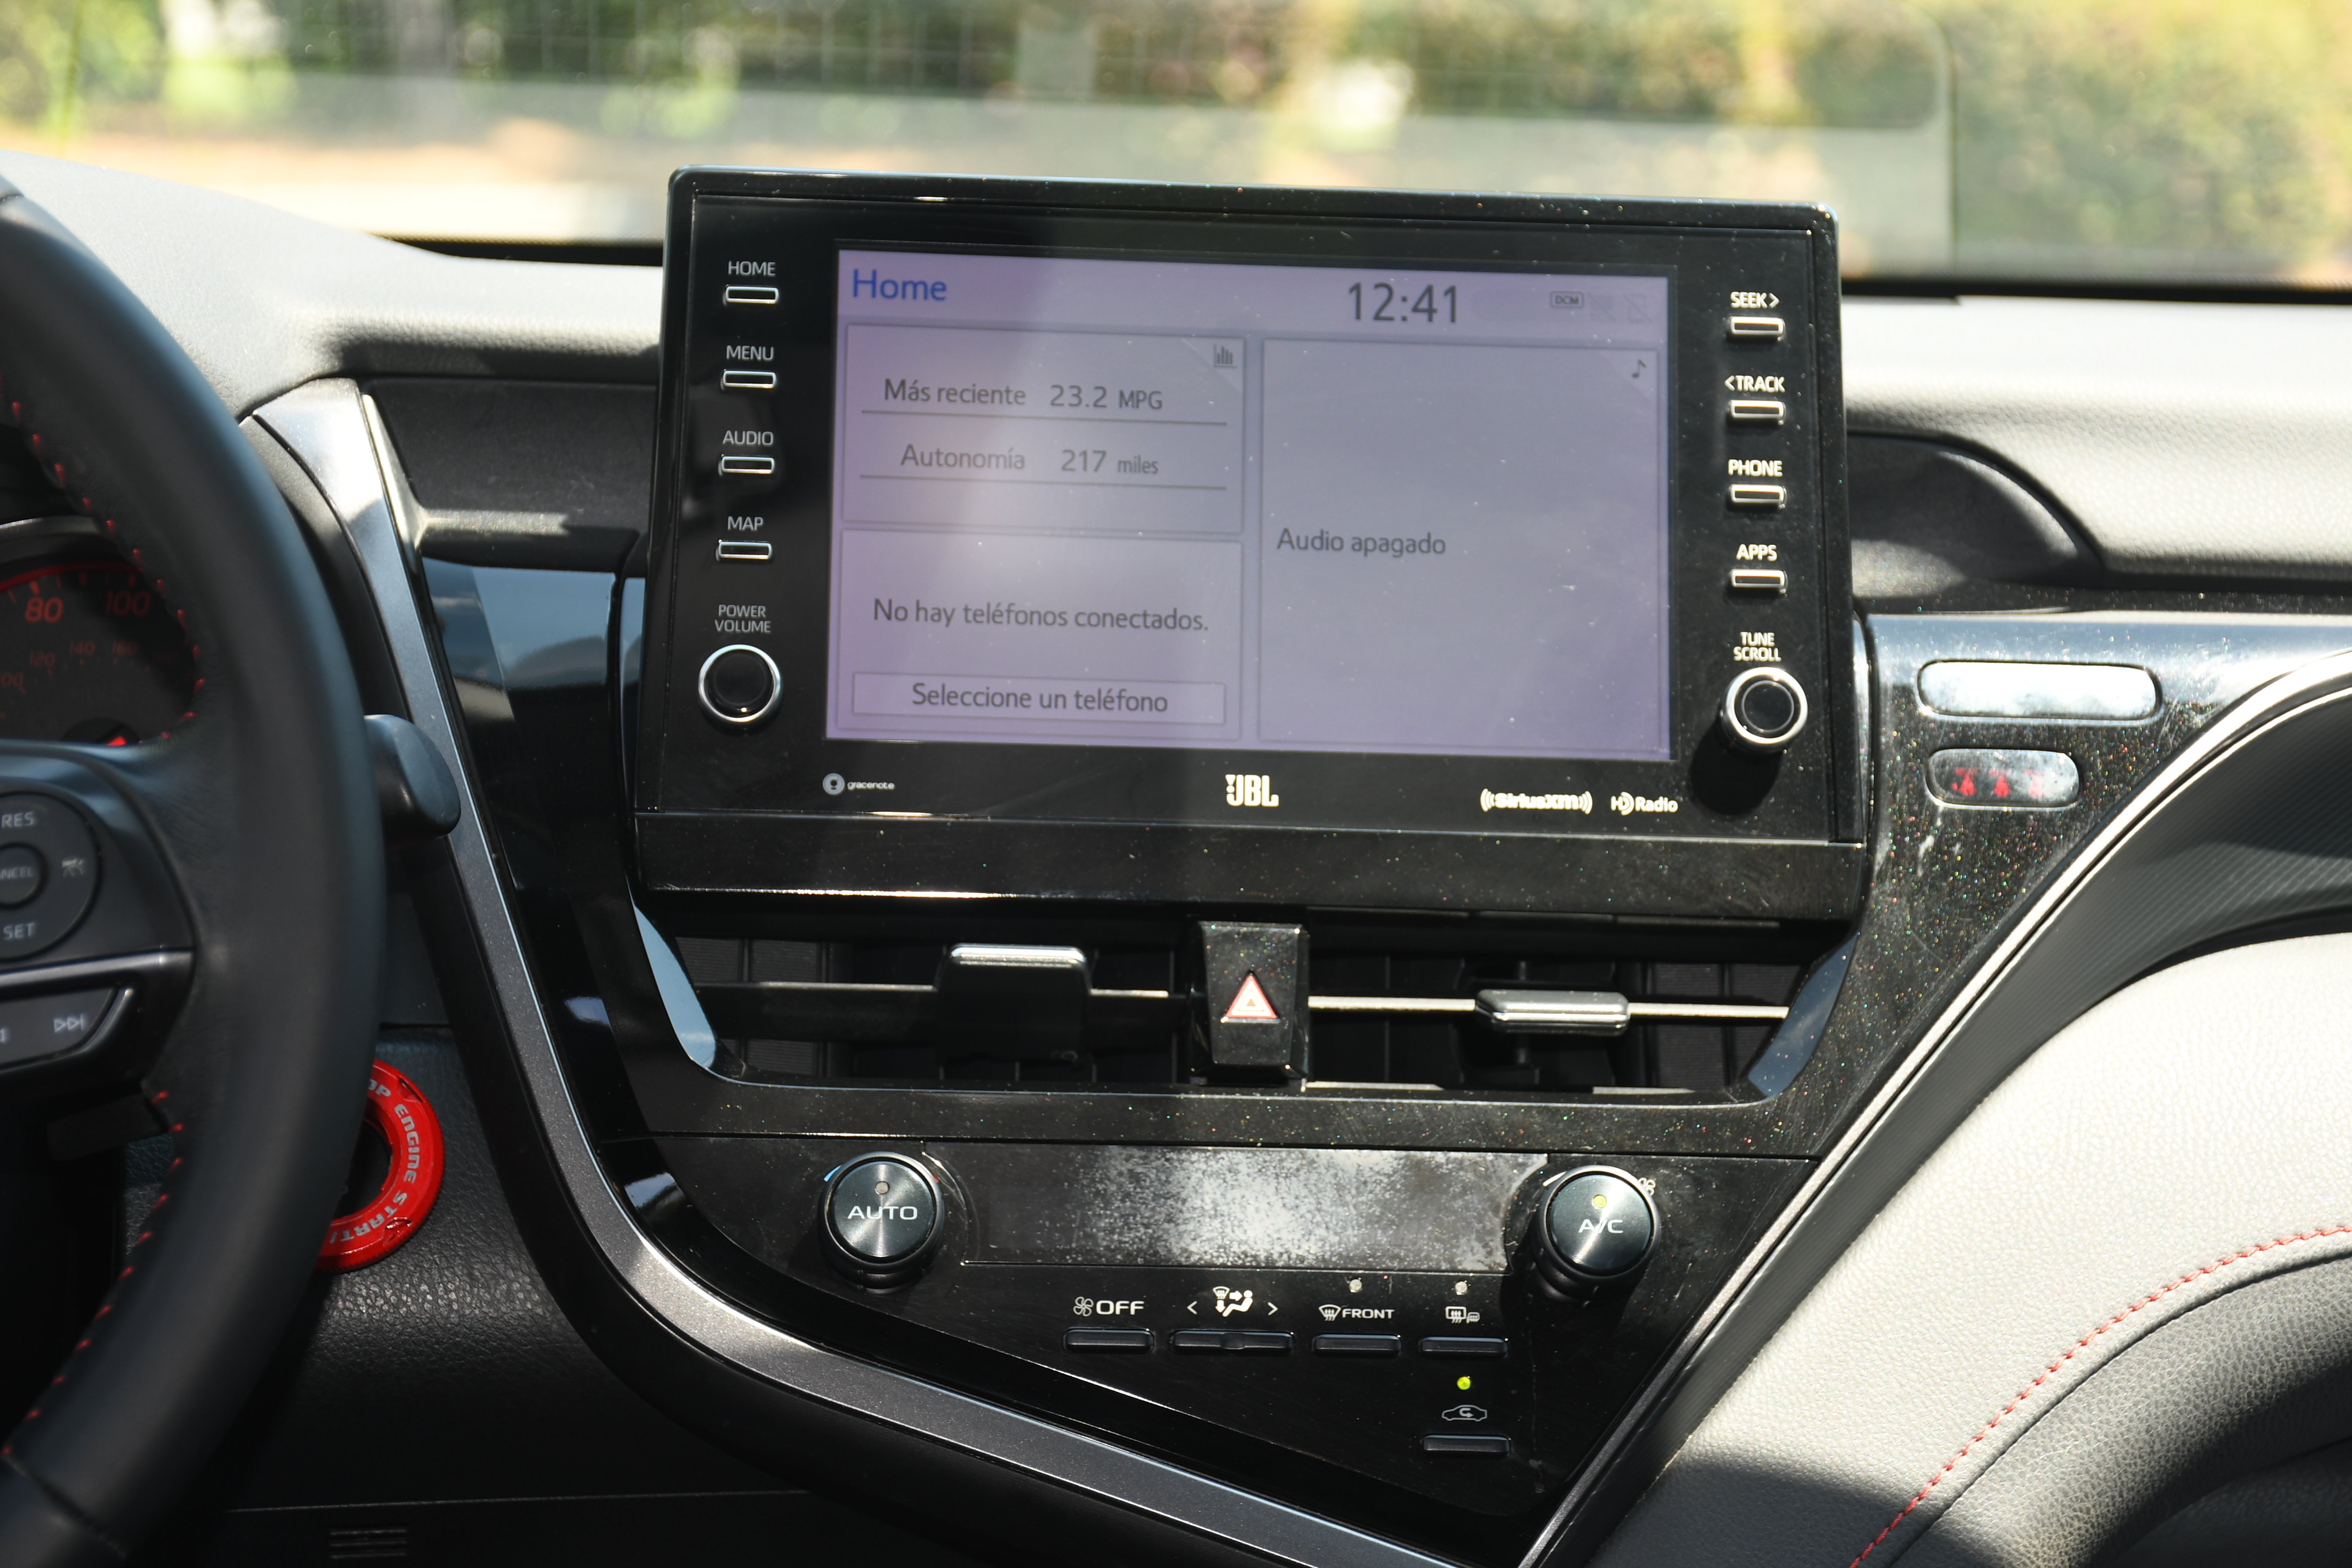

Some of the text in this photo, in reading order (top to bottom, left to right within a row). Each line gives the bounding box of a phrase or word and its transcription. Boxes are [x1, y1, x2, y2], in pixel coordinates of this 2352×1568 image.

[728, 261, 775, 276] HOME
[853, 269, 947, 300] Home
[1349, 282, 1457, 323] 12:41
[726, 345, 774, 361] MENU
[885, 378, 1162, 410] Más reciente 23.2 MPG
[722, 430, 773, 446] AUDIO
[900, 444, 1159, 474] Autonomía 217 miles
[1728, 459, 1783, 477] PHONE
[727, 516, 763, 531] MAP
[1277, 528, 1446, 558] Audio apagado
[1736, 544, 1778, 561] APPS
[25, 597, 63, 623] 80
[106, 591, 151, 616] 100
[719, 604, 766, 618] POWER
[874, 598, 1208, 630] No hay teléfonos conectados.
[715, 620, 770, 633] VOLUME
[1740, 632, 1775, 646] TUNE
[69, 640, 95, 656] 140
[1734, 647, 1781, 662] SCROLL
[0, 672, 24, 689] 00
[912, 682, 1168, 712] Seleccione un teléfono
[847, 782, 895, 791] gracenote
[1225, 774, 1279, 807] JBL
[1635, 797, 1678, 812] Radio
[1, 811, 35, 828] RES
[3, 922, 35, 940] SET
[394, 1103, 419, 1184] ENGINE
[847, 1205, 917, 1220] AUTO
[1579, 1219, 1623, 1234] A/C
[1096, 1300, 1144, 1315] OFF
[1342, 1308, 1394, 1319] FRONT
